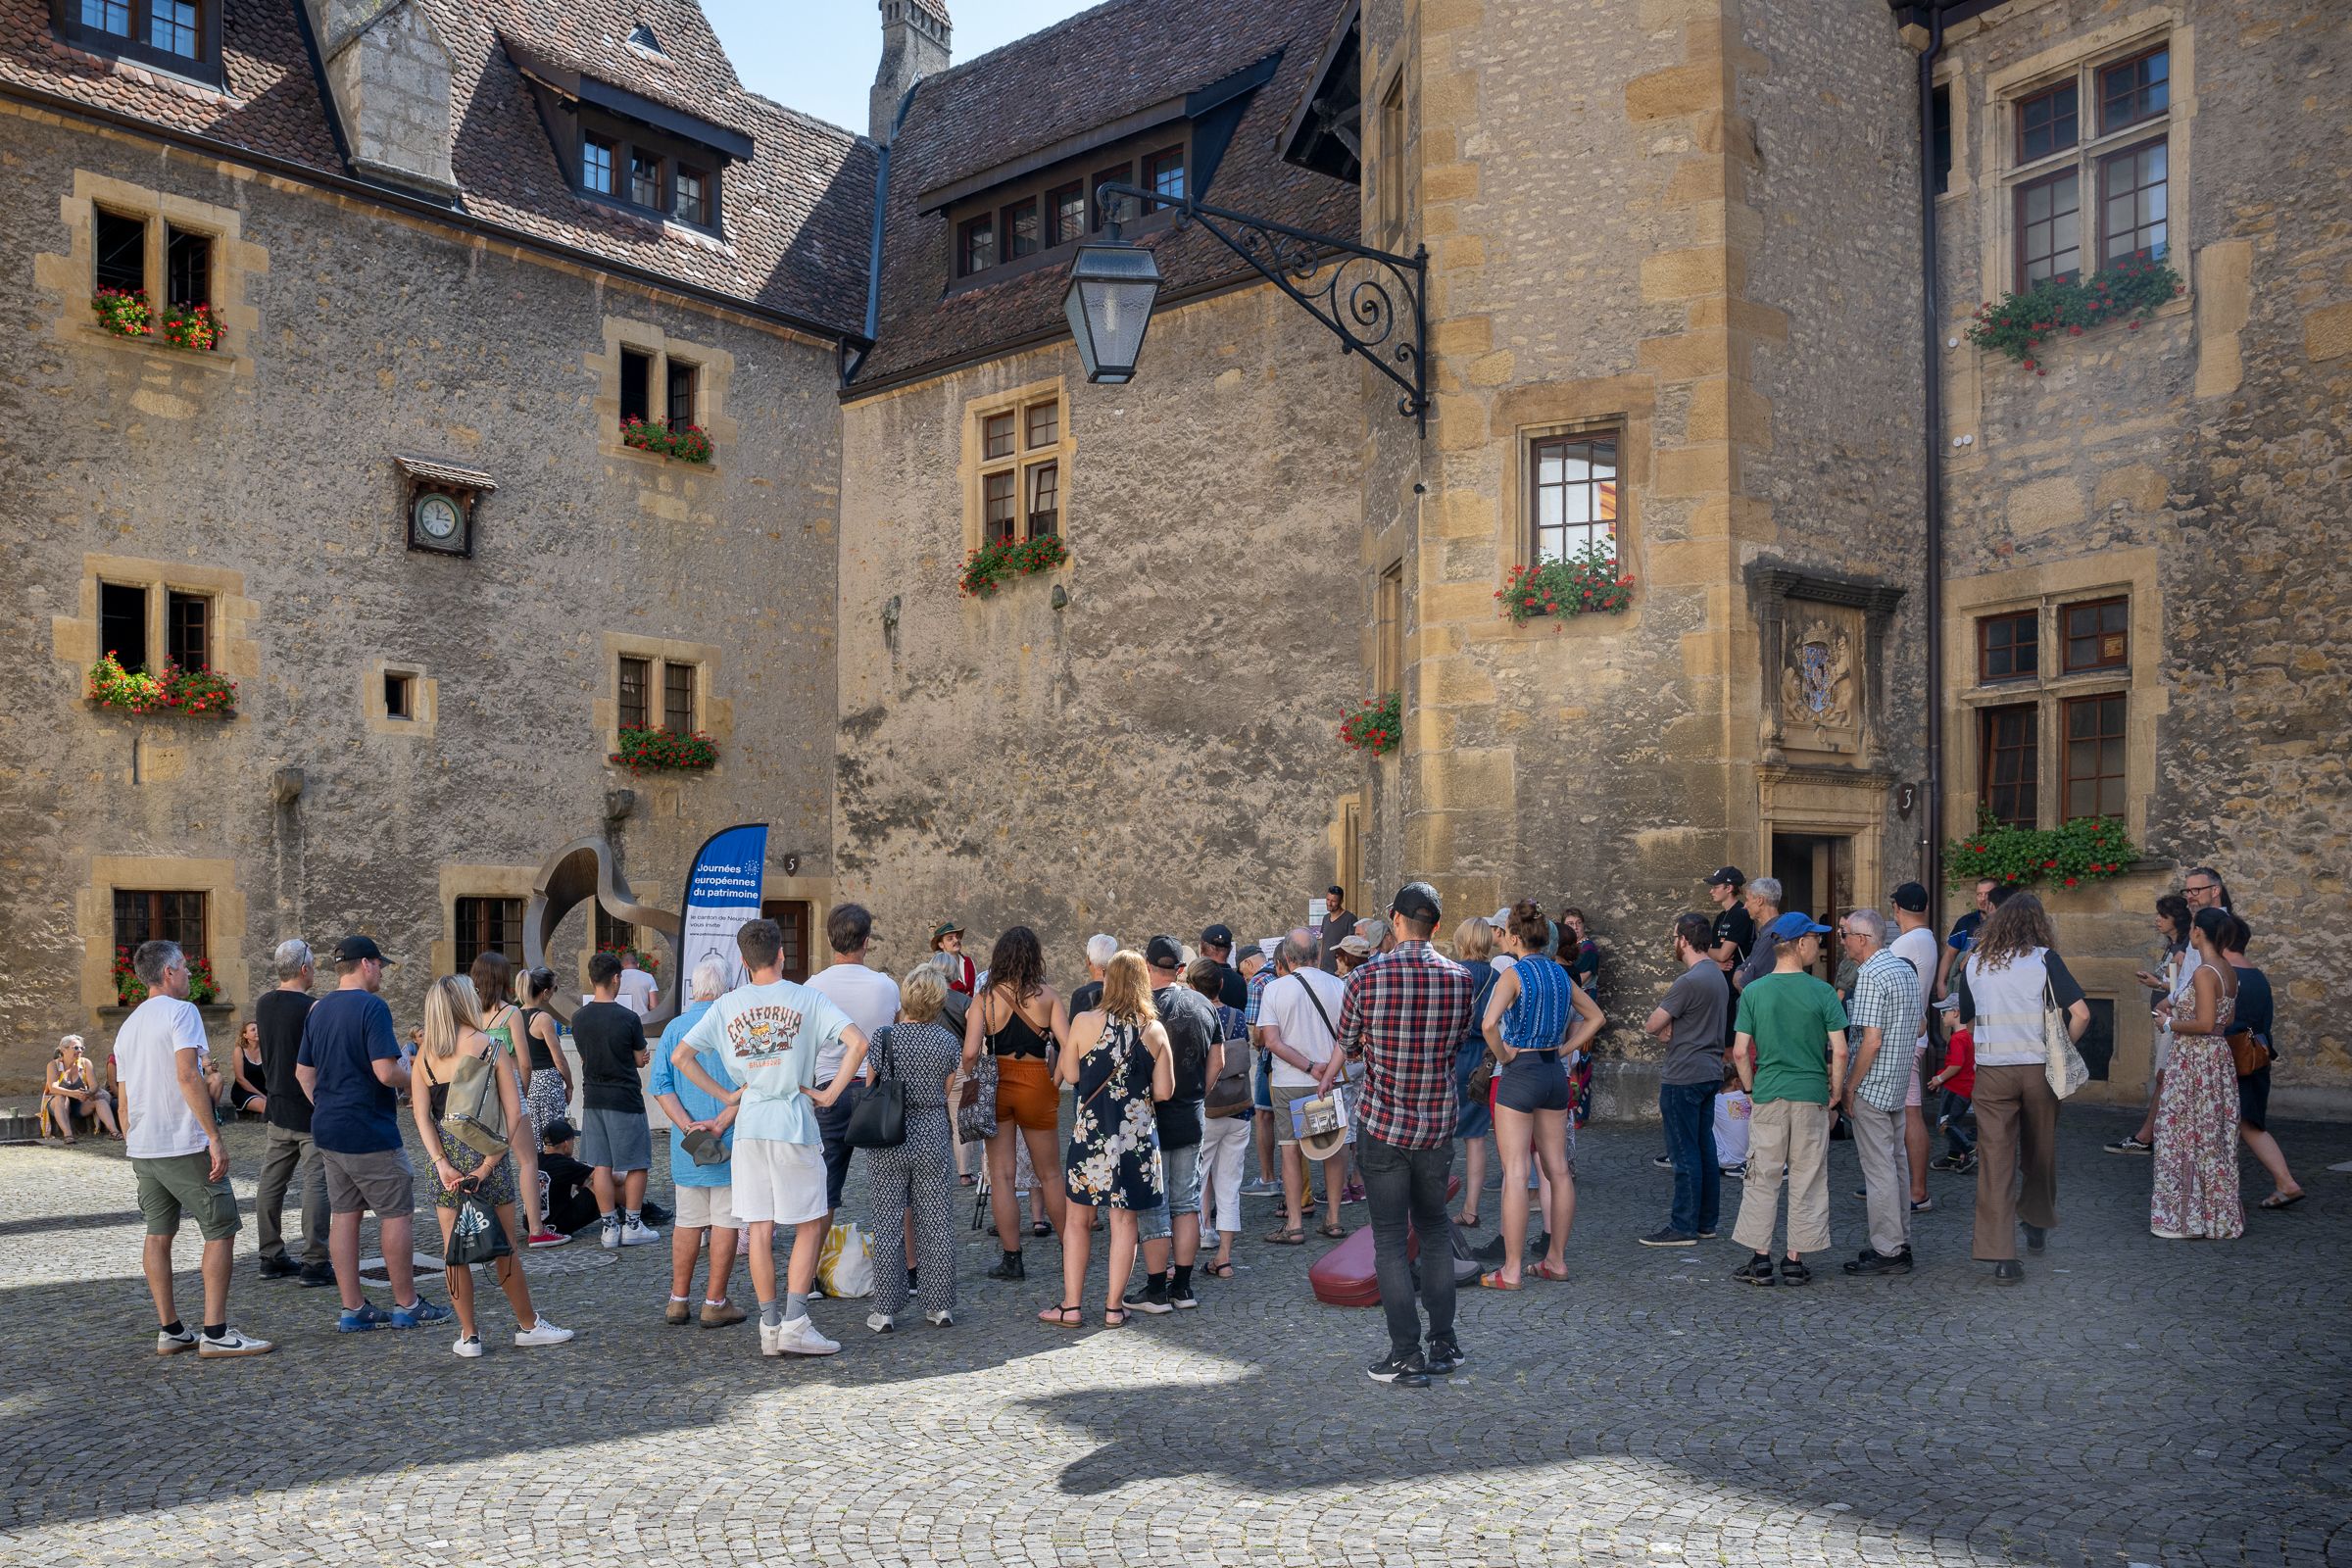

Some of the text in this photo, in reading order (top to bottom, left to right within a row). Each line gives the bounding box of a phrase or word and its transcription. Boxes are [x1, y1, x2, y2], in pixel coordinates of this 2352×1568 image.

[1902, 789, 1912, 808] 3
[698, 864, 742, 873] Journées
[788, 858, 795, 870] 5
[695, 876, 756, 887] européennes
[708, 889, 759, 900] patrimoine
[728, 1005, 803, 1043] CALIFORNIA
